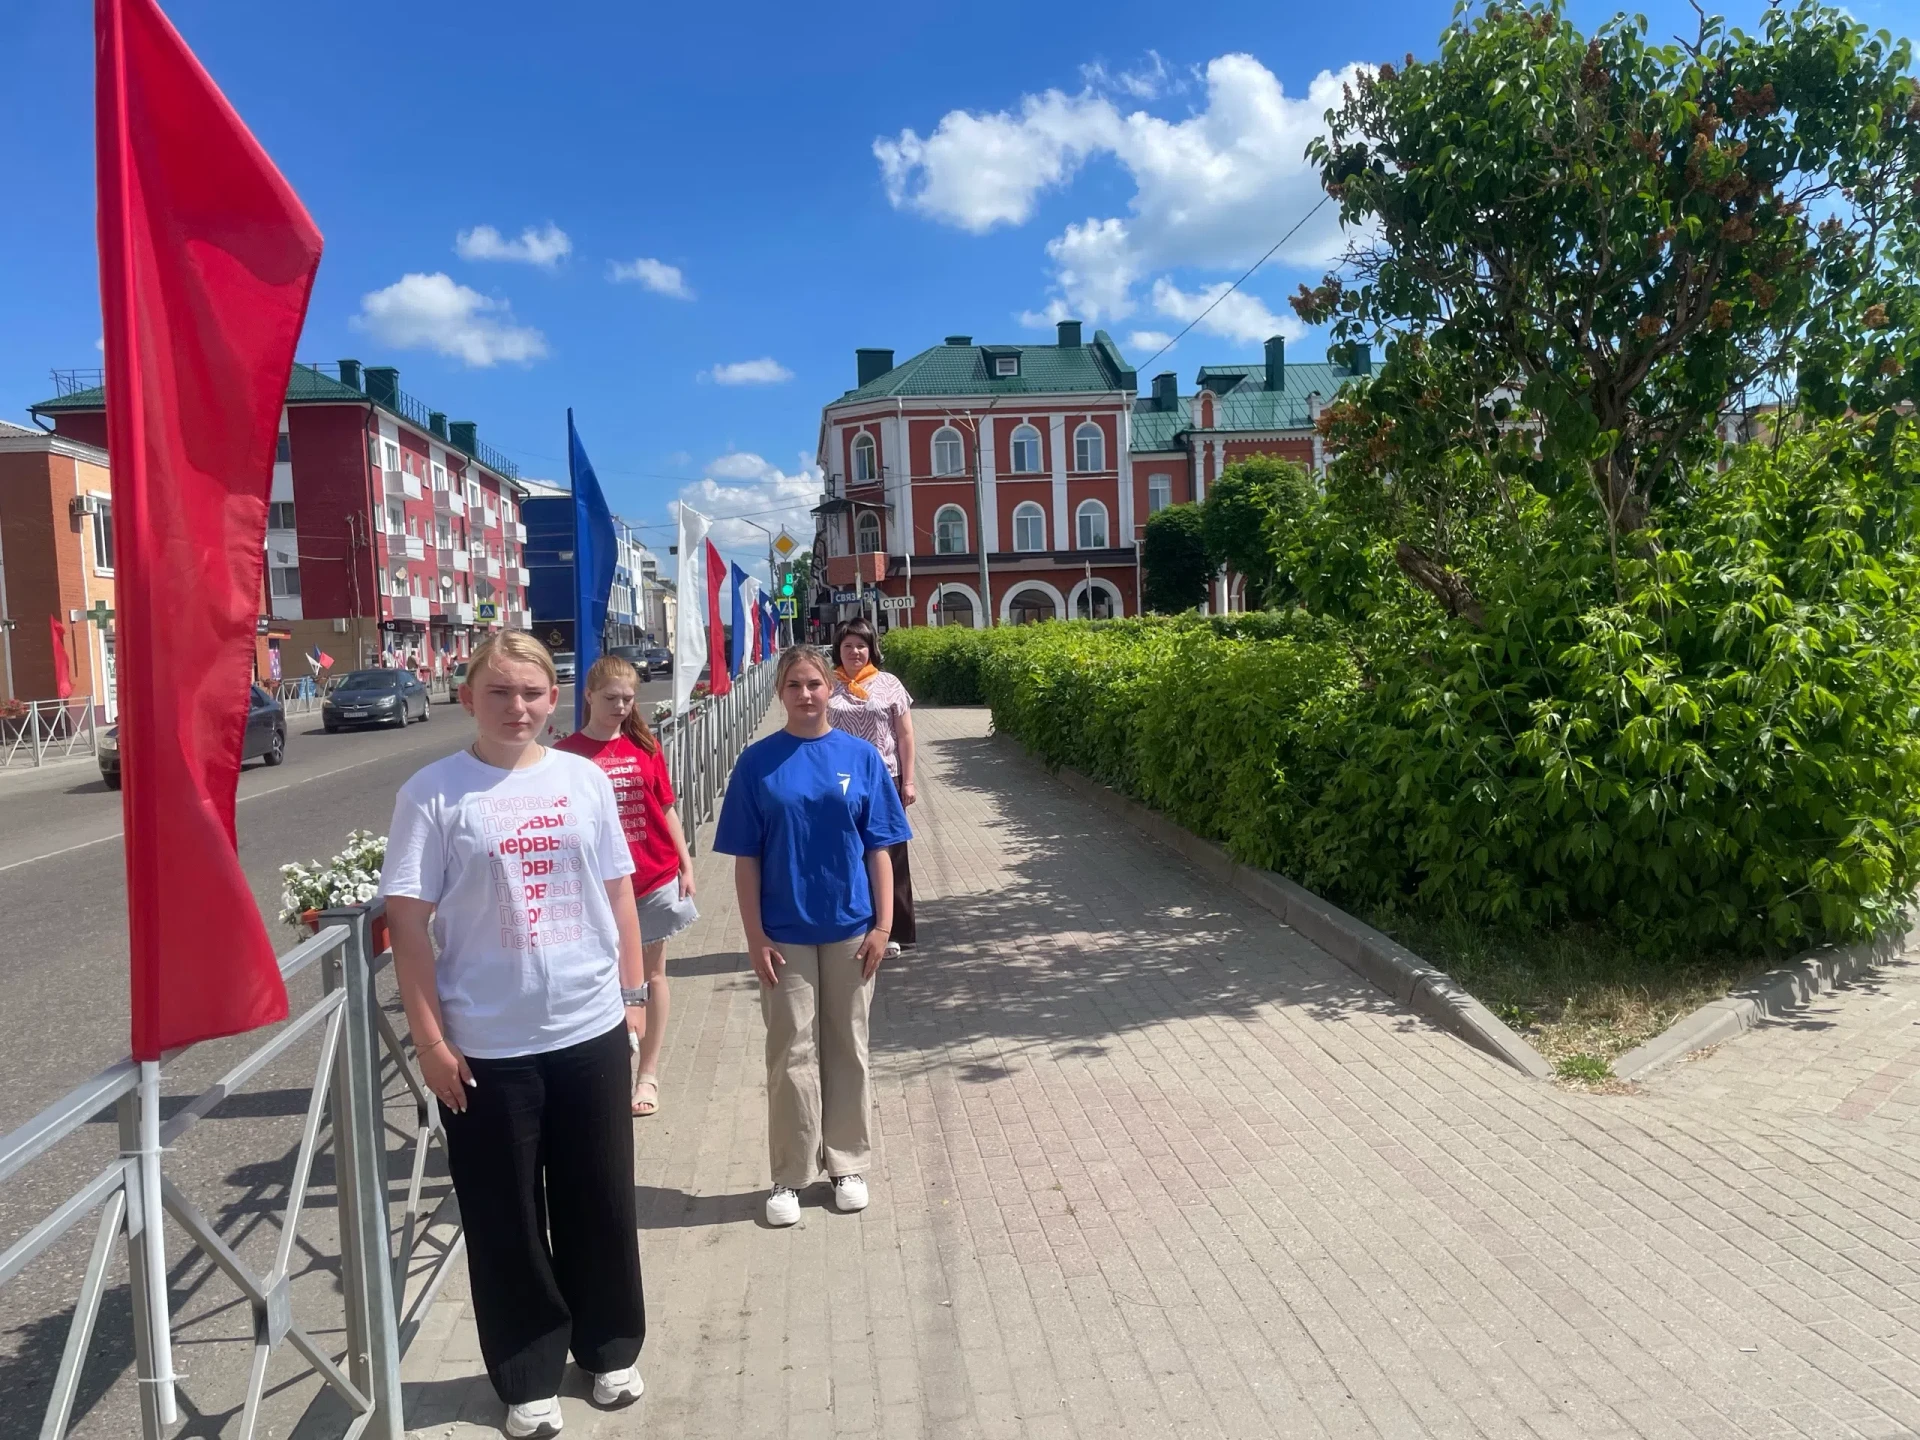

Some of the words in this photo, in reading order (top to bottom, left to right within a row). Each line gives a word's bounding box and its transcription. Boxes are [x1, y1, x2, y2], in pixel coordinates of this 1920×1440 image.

[883, 597, 912, 608] СТОП
[478, 795, 571, 815] Первые
[482, 813, 577, 836] Первые
[486, 833, 582, 860] Первые
[490, 856, 582, 881] Первые
[495, 880, 583, 906] Первые
[500, 901, 583, 930] Первые
[501, 924, 583, 954] Первые
